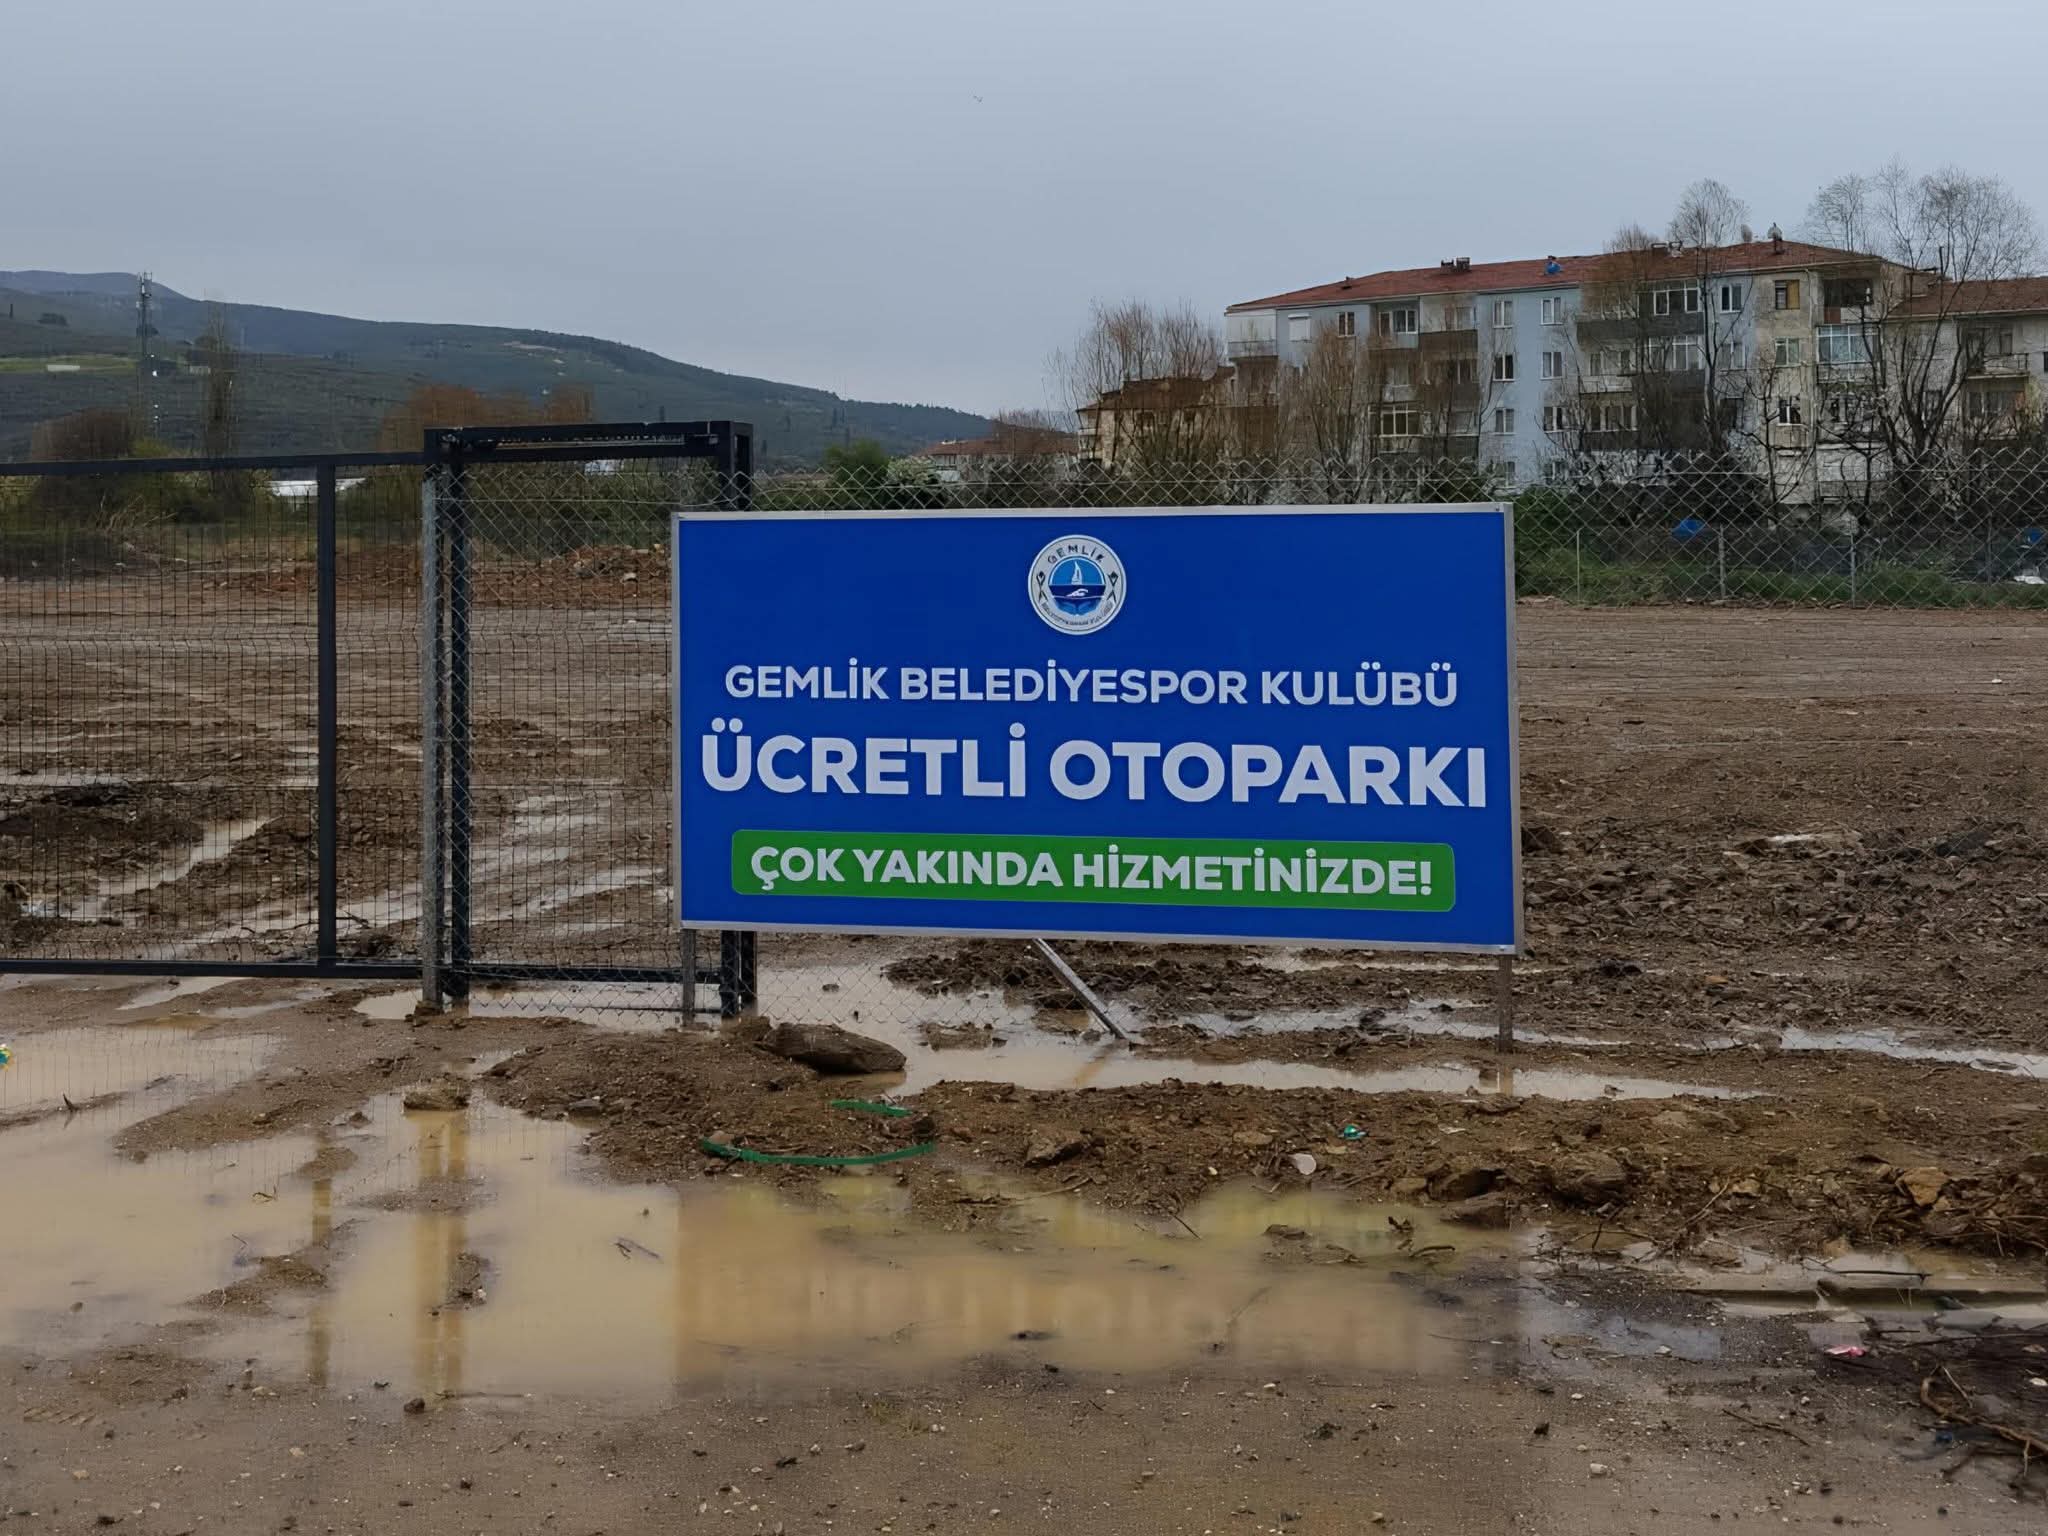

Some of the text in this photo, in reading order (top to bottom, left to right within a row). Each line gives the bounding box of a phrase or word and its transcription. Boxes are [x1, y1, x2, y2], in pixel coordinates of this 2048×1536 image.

[725, 657, 1458, 708] GEMLİK BELEDİYESPOR KULÜBÜ
[702, 717, 1487, 809] ÜCRETLİ OTOPARKI
[751, 844, 1433, 896] ÇOK YAKINDA HİZMETİNİZDE!
